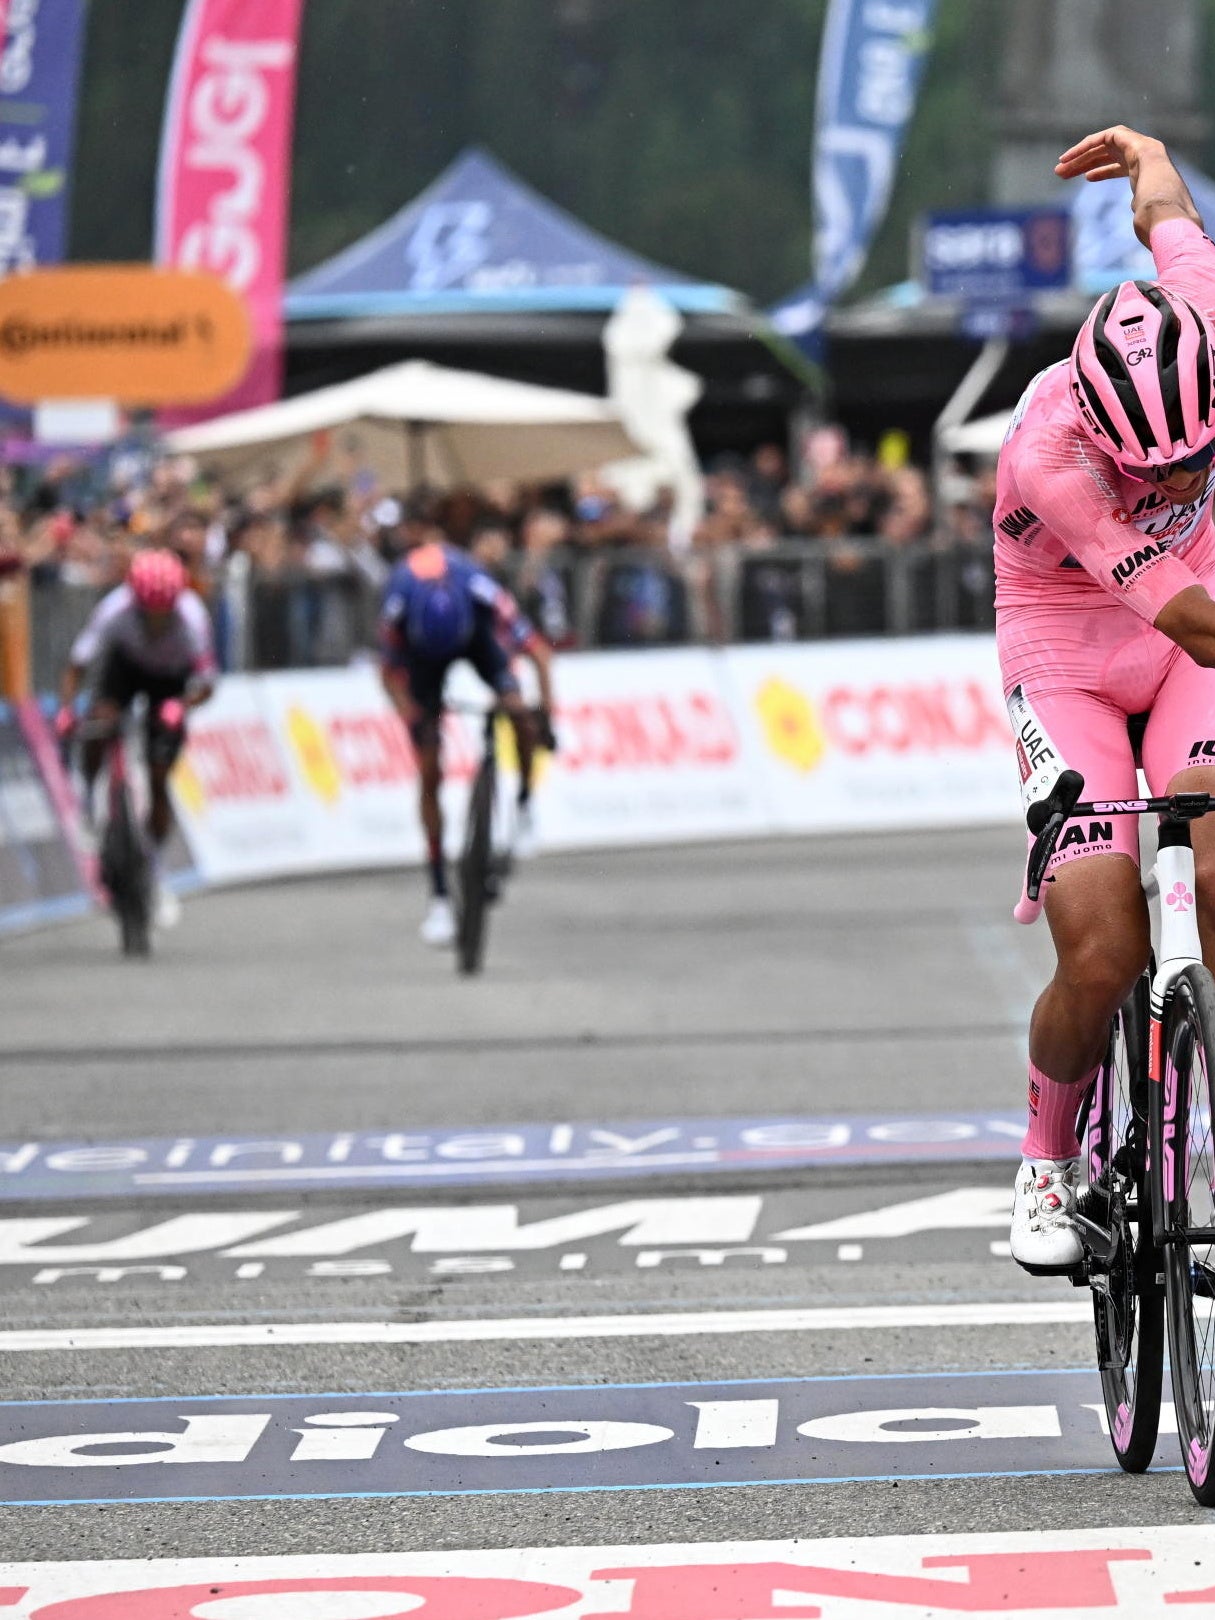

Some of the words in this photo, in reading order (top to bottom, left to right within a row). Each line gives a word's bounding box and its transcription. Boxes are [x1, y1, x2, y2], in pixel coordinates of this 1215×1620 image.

[1124, 325, 1144, 336] UAE
[1126, 347, 1154, 367] G42
[1072, 381, 1107, 439] MET
[1021, 719, 1056, 771] UAE
[1052, 821, 1114, 856] AN
[1073, 843, 1113, 856] uomo
